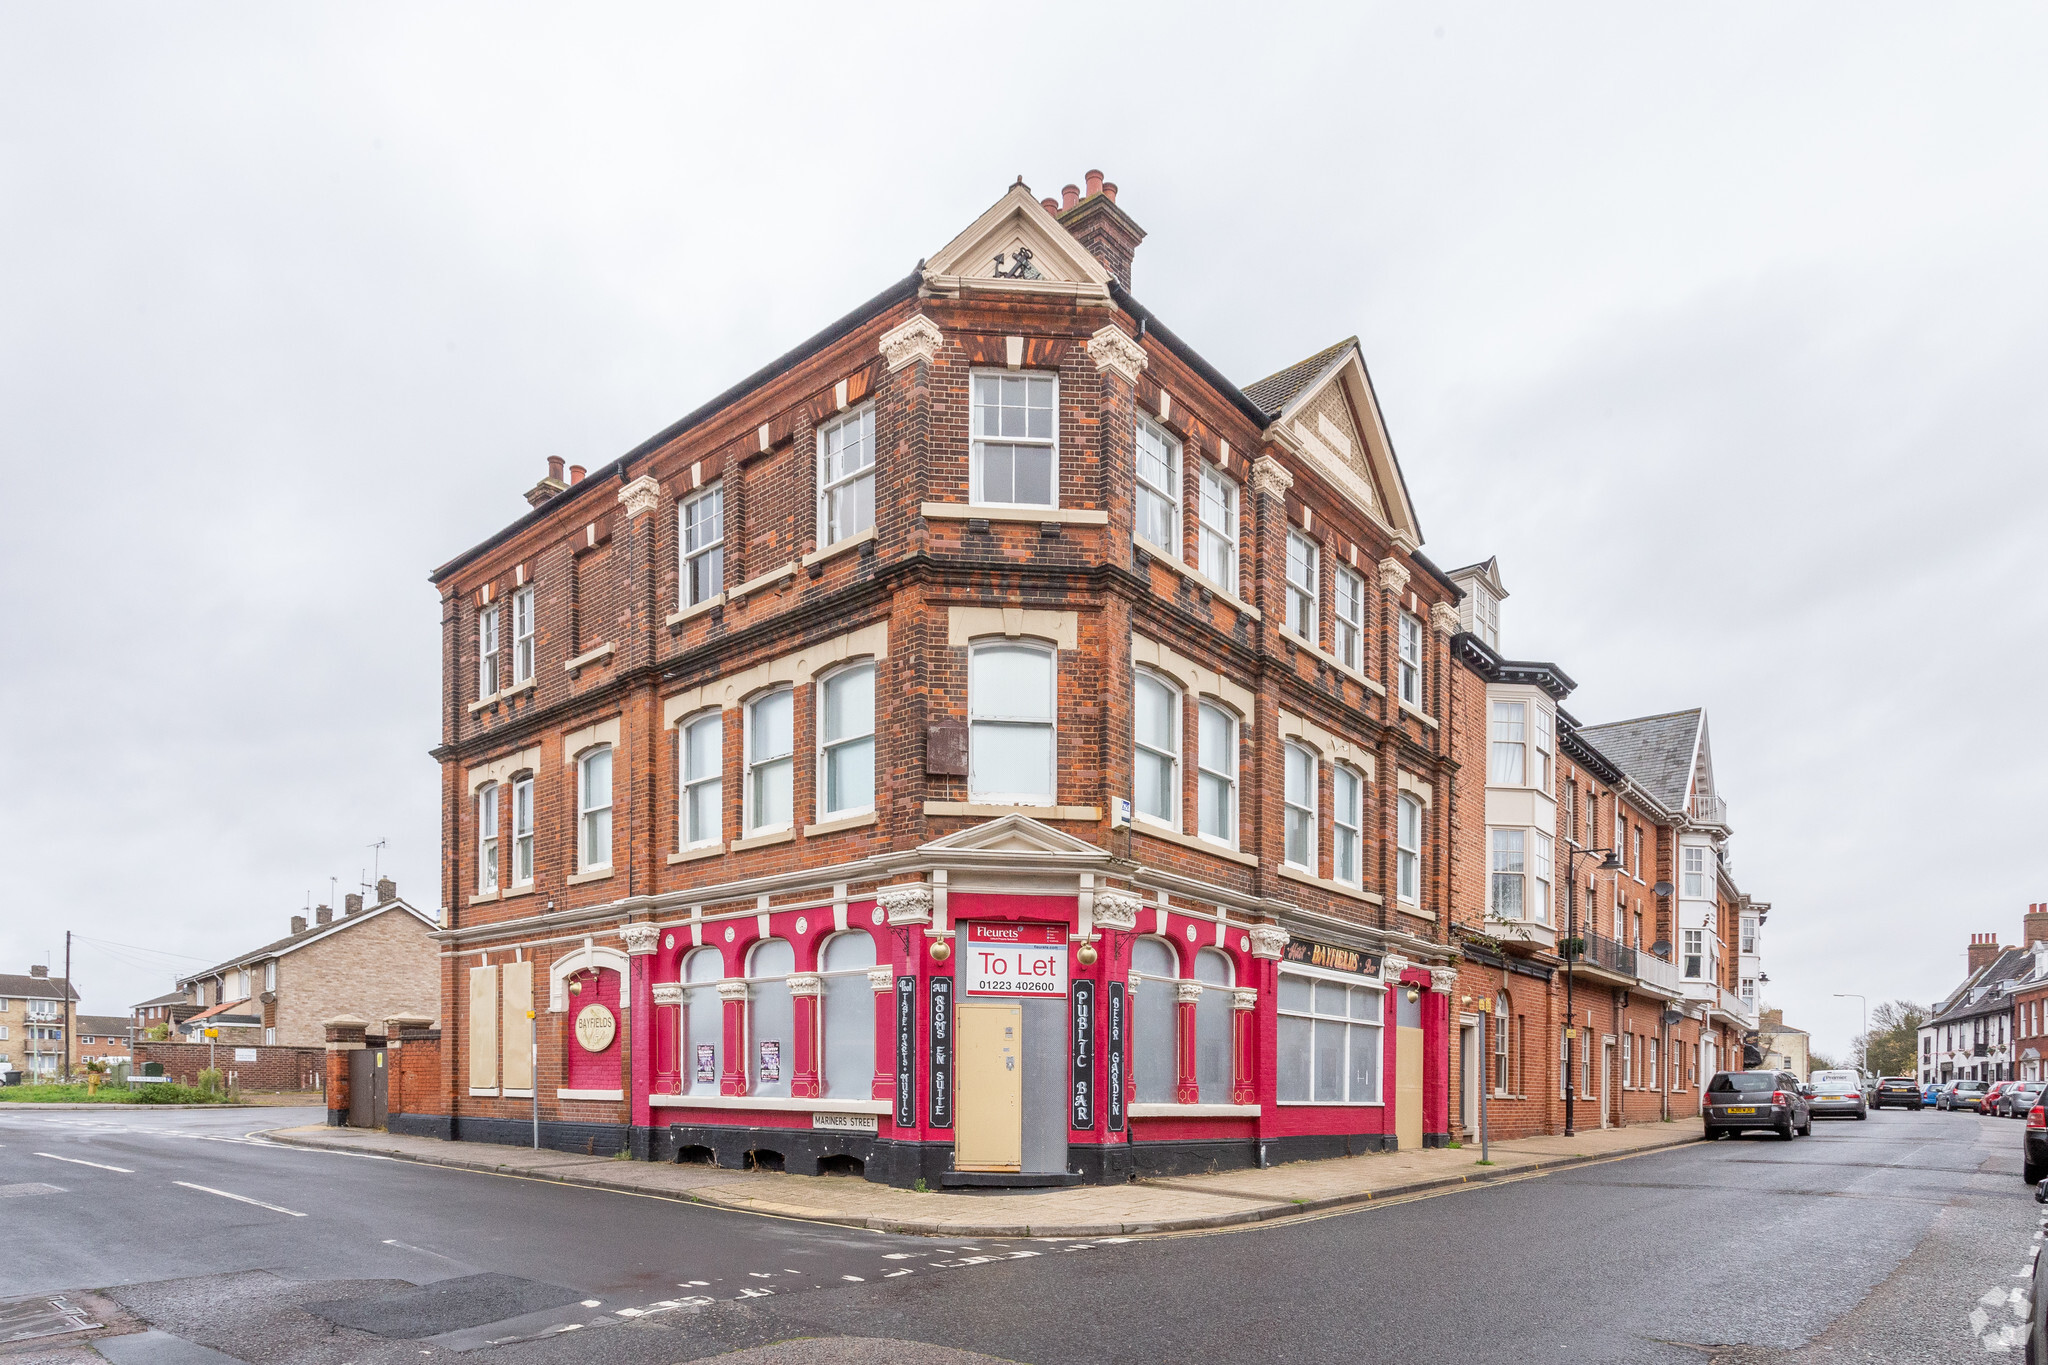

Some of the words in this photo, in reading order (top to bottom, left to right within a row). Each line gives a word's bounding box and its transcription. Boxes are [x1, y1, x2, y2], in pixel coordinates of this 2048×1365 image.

[977, 926, 1018, 938] Fleurets
[978, 952, 1007, 975] To
[1018, 953, 1056, 977] Let
[1312, 944, 1360, 972] BAYFIELDS
[979, 980, 1012, 990] 01223
[1015, 981, 1055, 991] 402600
[578, 1016, 612, 1029] BAYFIELDS
[934, 995, 947, 1039] ROOMS
[1076, 991, 1089, 1068] PUBLIC
[1112, 997, 1120, 1041] BEER
[936, 1046, 946, 1065] EN
[900, 1073, 909, 1116] MUSIC
[935, 1071, 945, 1115] SUITE
[1111, 1051, 1120, 1116] GARDEN
[1074, 1081, 1089, 1120] BAR
[814, 1115, 847, 1126] MARINERS
[850, 1117, 875, 1127] STREET
